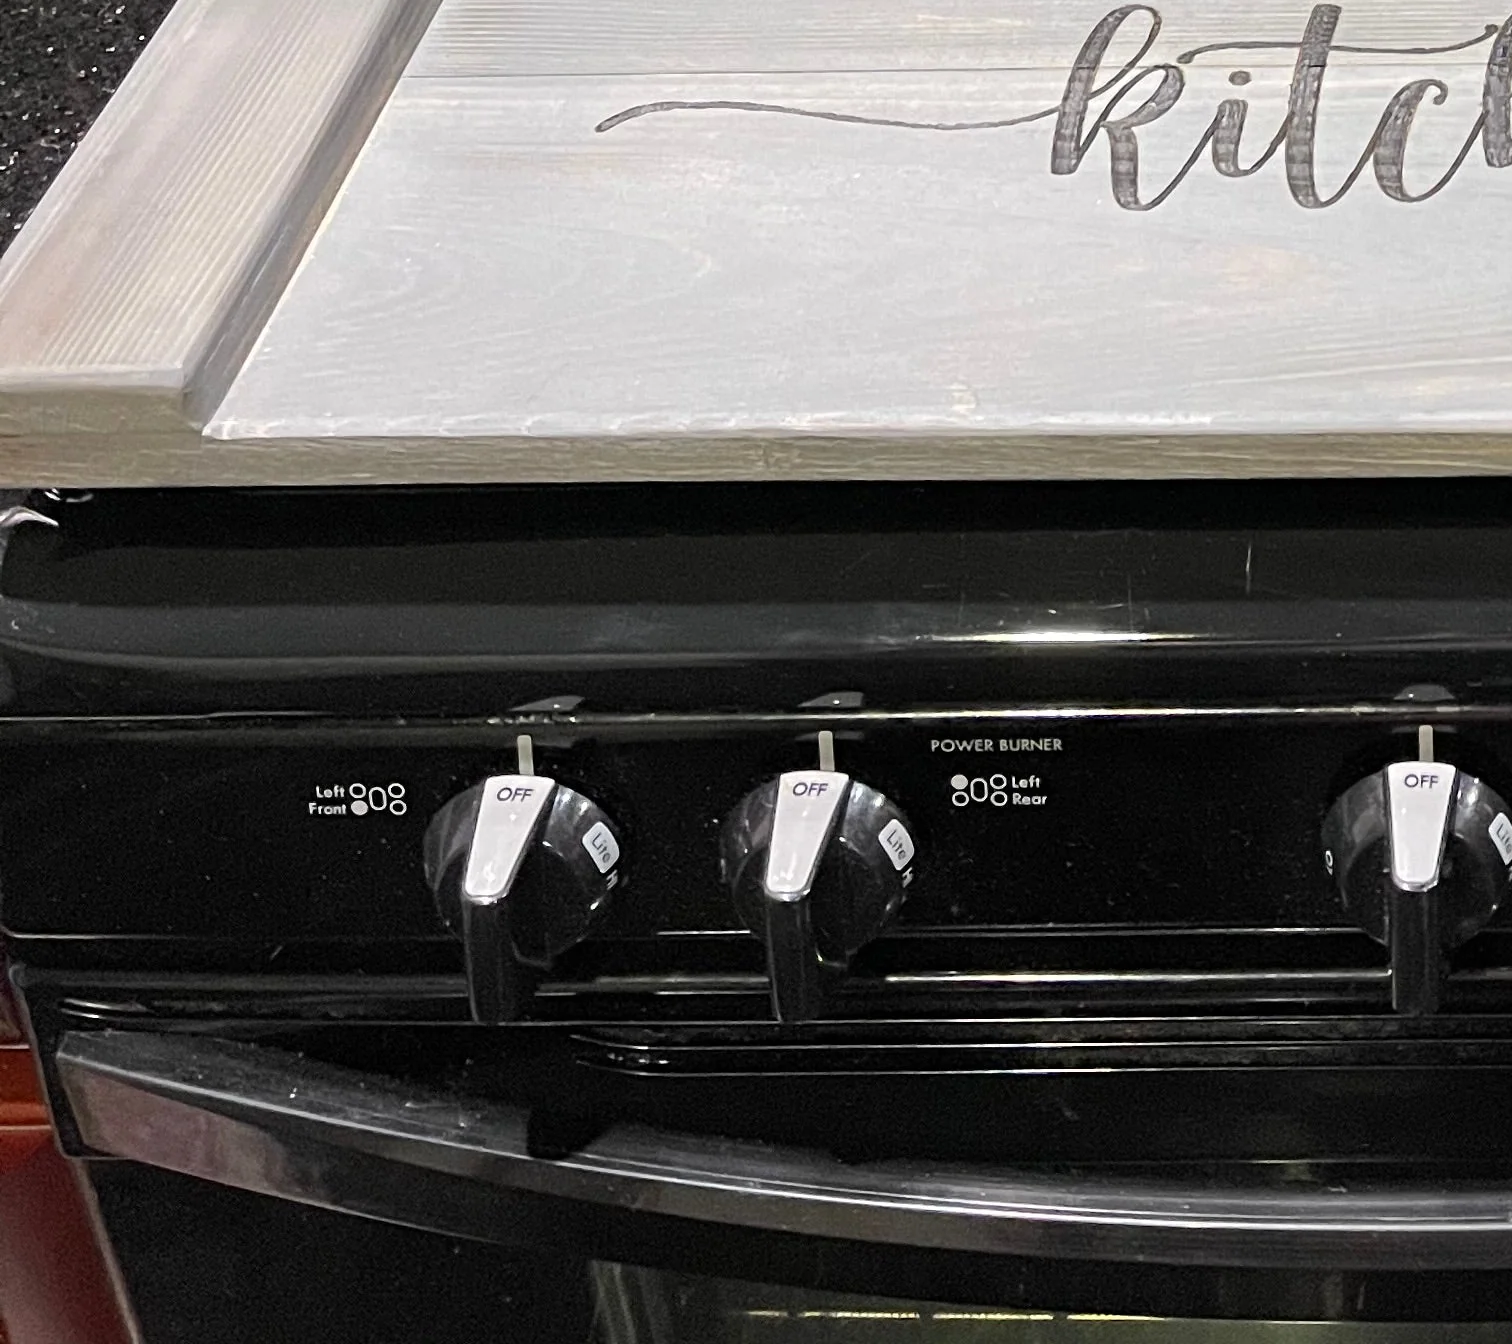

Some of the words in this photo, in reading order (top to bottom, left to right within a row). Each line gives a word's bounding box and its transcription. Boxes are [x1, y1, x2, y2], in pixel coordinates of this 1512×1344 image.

[931, 739, 994, 753] POWER
[999, 738, 1064, 752] BURNER
[1011, 775, 1040, 789] Left
[1404, 773, 1439, 789] OFF
[315, 785, 345, 799] Left
[496, 786, 534, 803] OFF
[792, 782, 829, 797] OFF
[1012, 793, 1047, 805] Rear
[308, 802, 347, 815] Front
[886, 828, 907, 861] Lite
[1496, 822, 1512, 854] Lite
[591, 832, 611, 864] Lite
